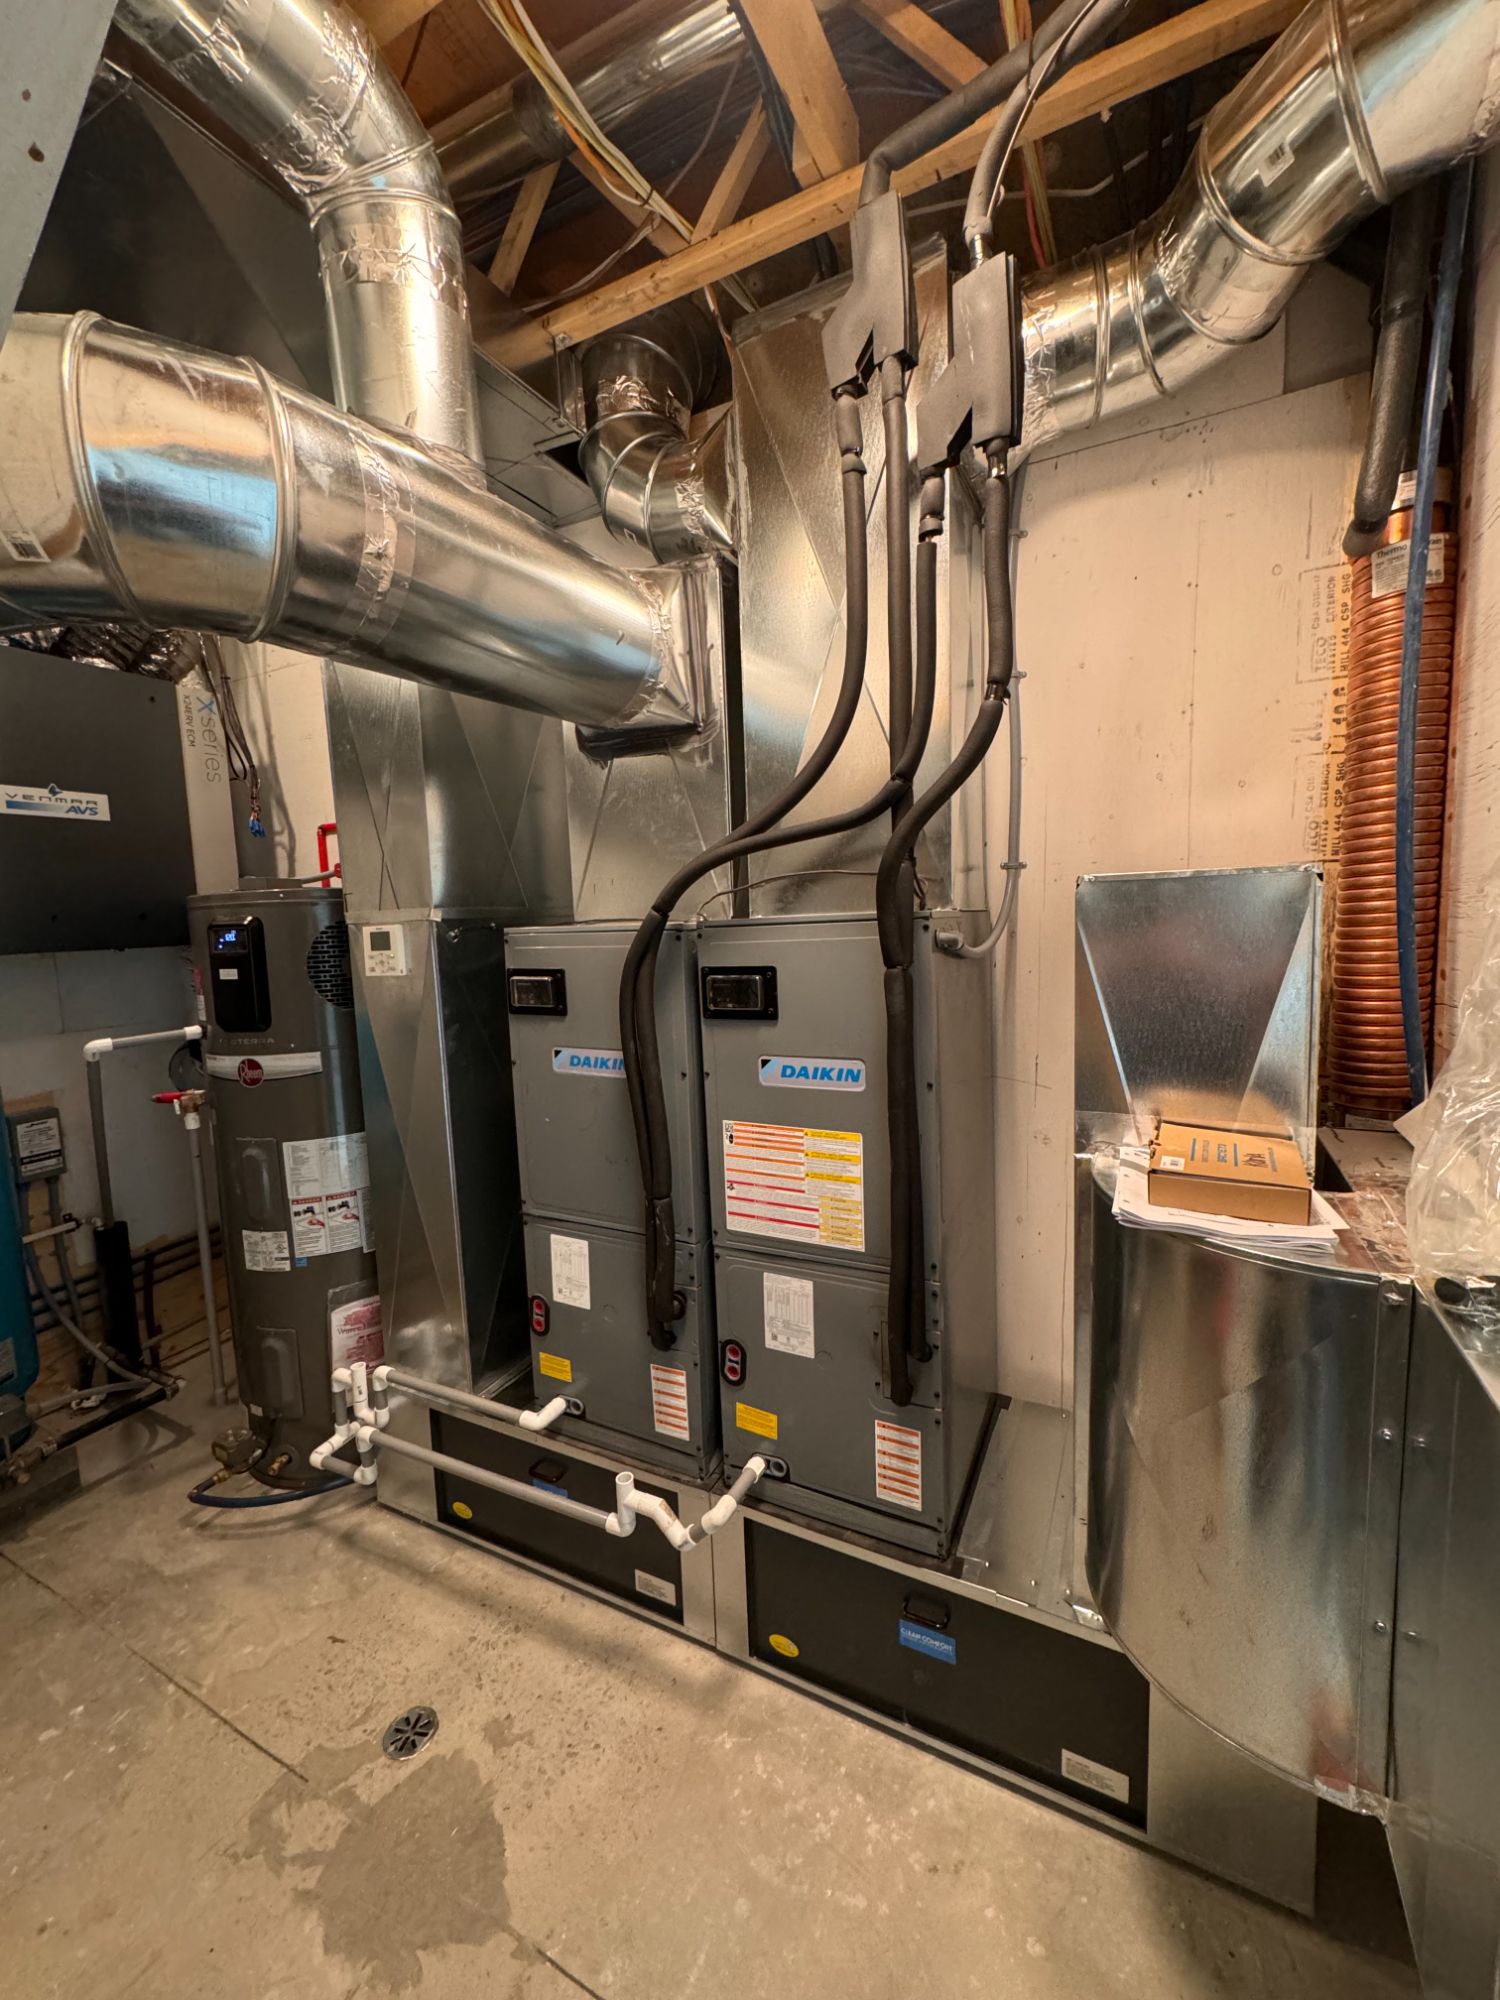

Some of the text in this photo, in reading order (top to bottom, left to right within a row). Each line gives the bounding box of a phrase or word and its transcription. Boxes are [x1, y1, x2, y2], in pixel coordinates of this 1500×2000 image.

[1377, 544, 1407, 558] Thermo
[1326, 575, 1336, 623] EXTERIOR
[1340, 573, 1351, 672] MILL 444 CSP SHG
[1314, 636, 1327, 673] TECO
[186, 728, 196, 747] ECM
[5, 792, 98, 806] VENMAR
[1319, 763, 1330, 808] EXTERIOR
[65, 805, 98, 816] AVS
[1331, 762, 1345, 857] MILL 444 CSP SHG
[1306, 820, 1320, 854] TECO
[240, 1060, 263, 1082] Rheem
[781, 1065, 861, 1083] DAIKIN
